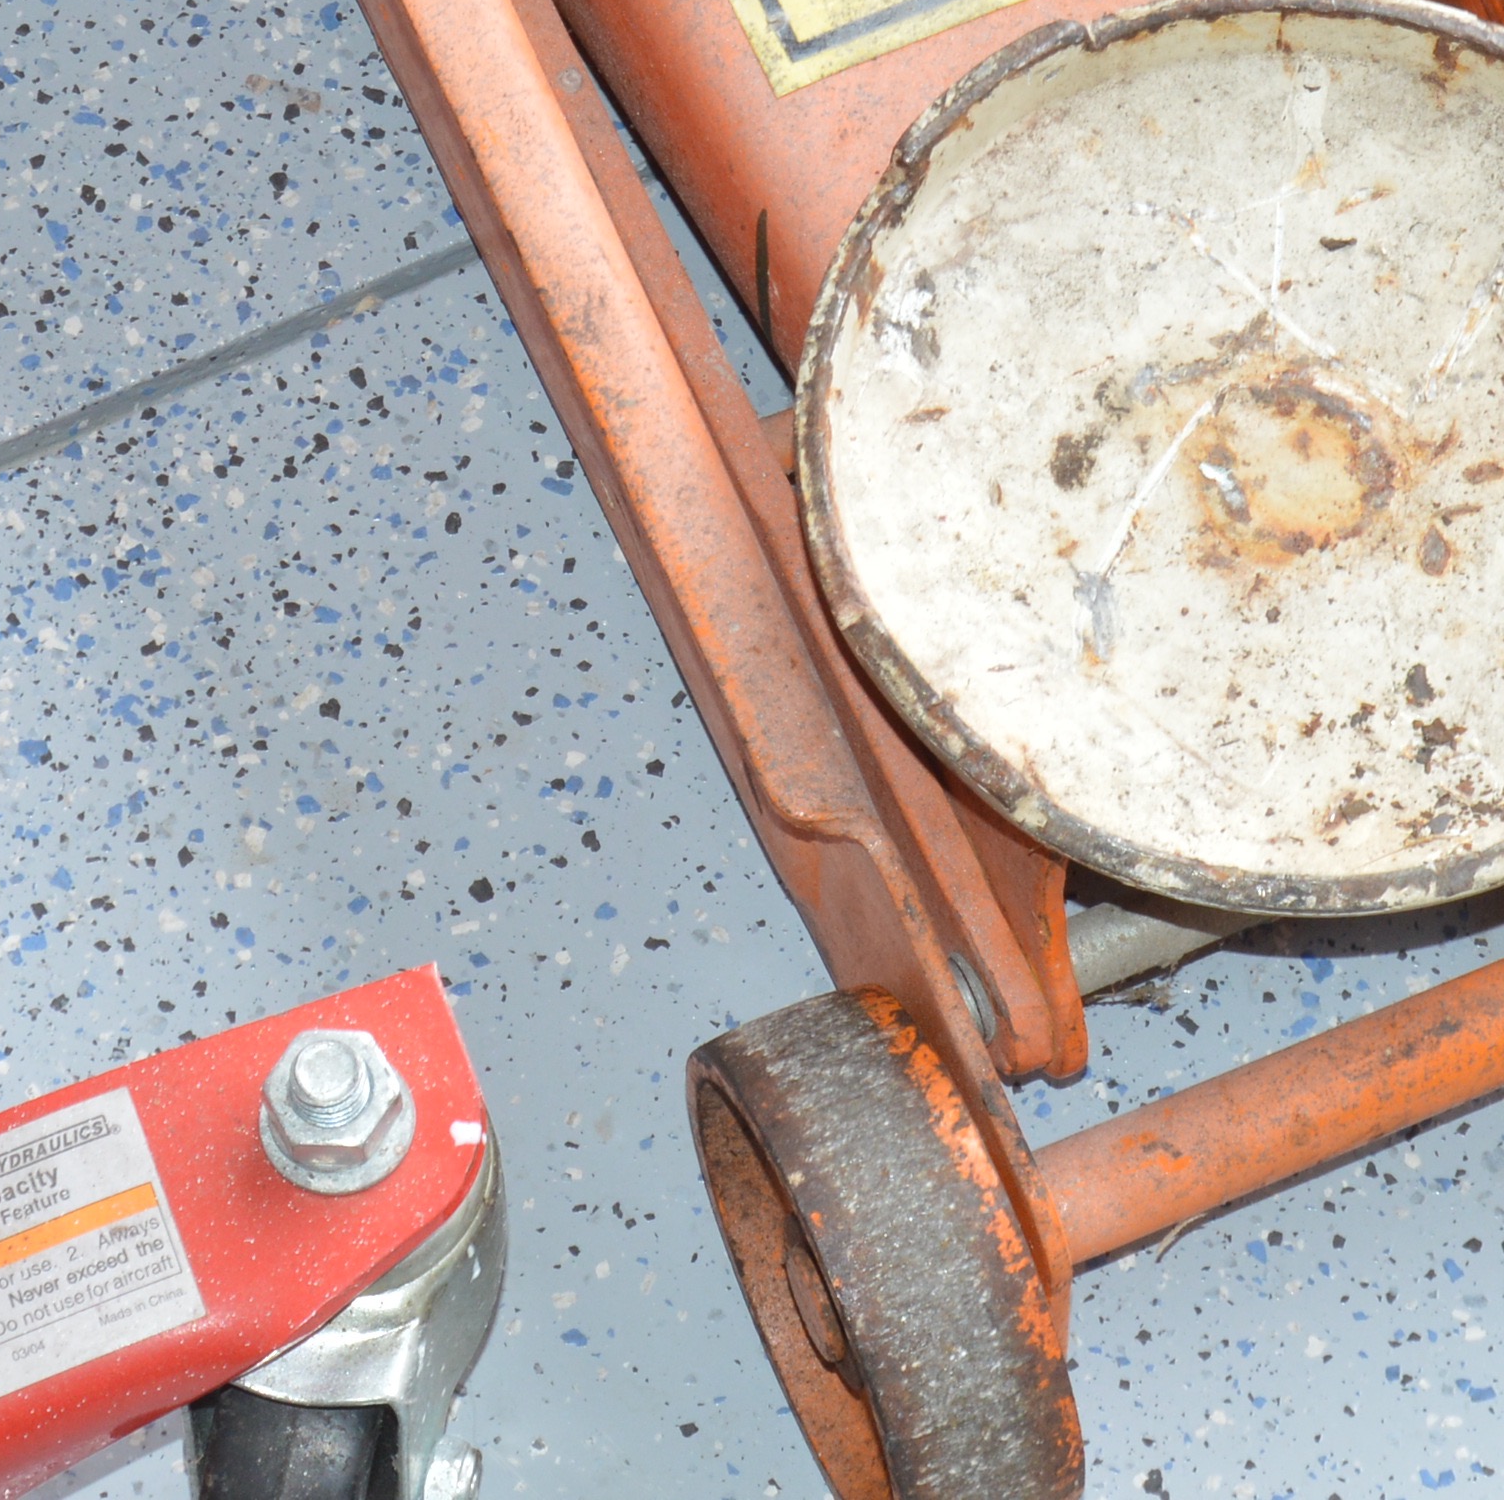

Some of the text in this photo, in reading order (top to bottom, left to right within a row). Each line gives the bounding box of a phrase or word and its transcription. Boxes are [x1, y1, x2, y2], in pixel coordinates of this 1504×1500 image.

[64, 1242, 85, 1263] 2.
[94, 1212, 162, 1254] Always
[7, 1275, 62, 1309] Never
[64, 1248, 130, 1286] exceed
[135, 1234, 165, 1258] the
[21, 1302, 52, 1326] not
[52, 1290, 86, 1314] use
[85, 1277, 112, 1300] for
[110, 1252, 174, 1290] aircraft
[97, 1304, 133, 1327] Made
[133, 1299, 147, 1313] in
[10, 1339, 47, 1362] 03/04
